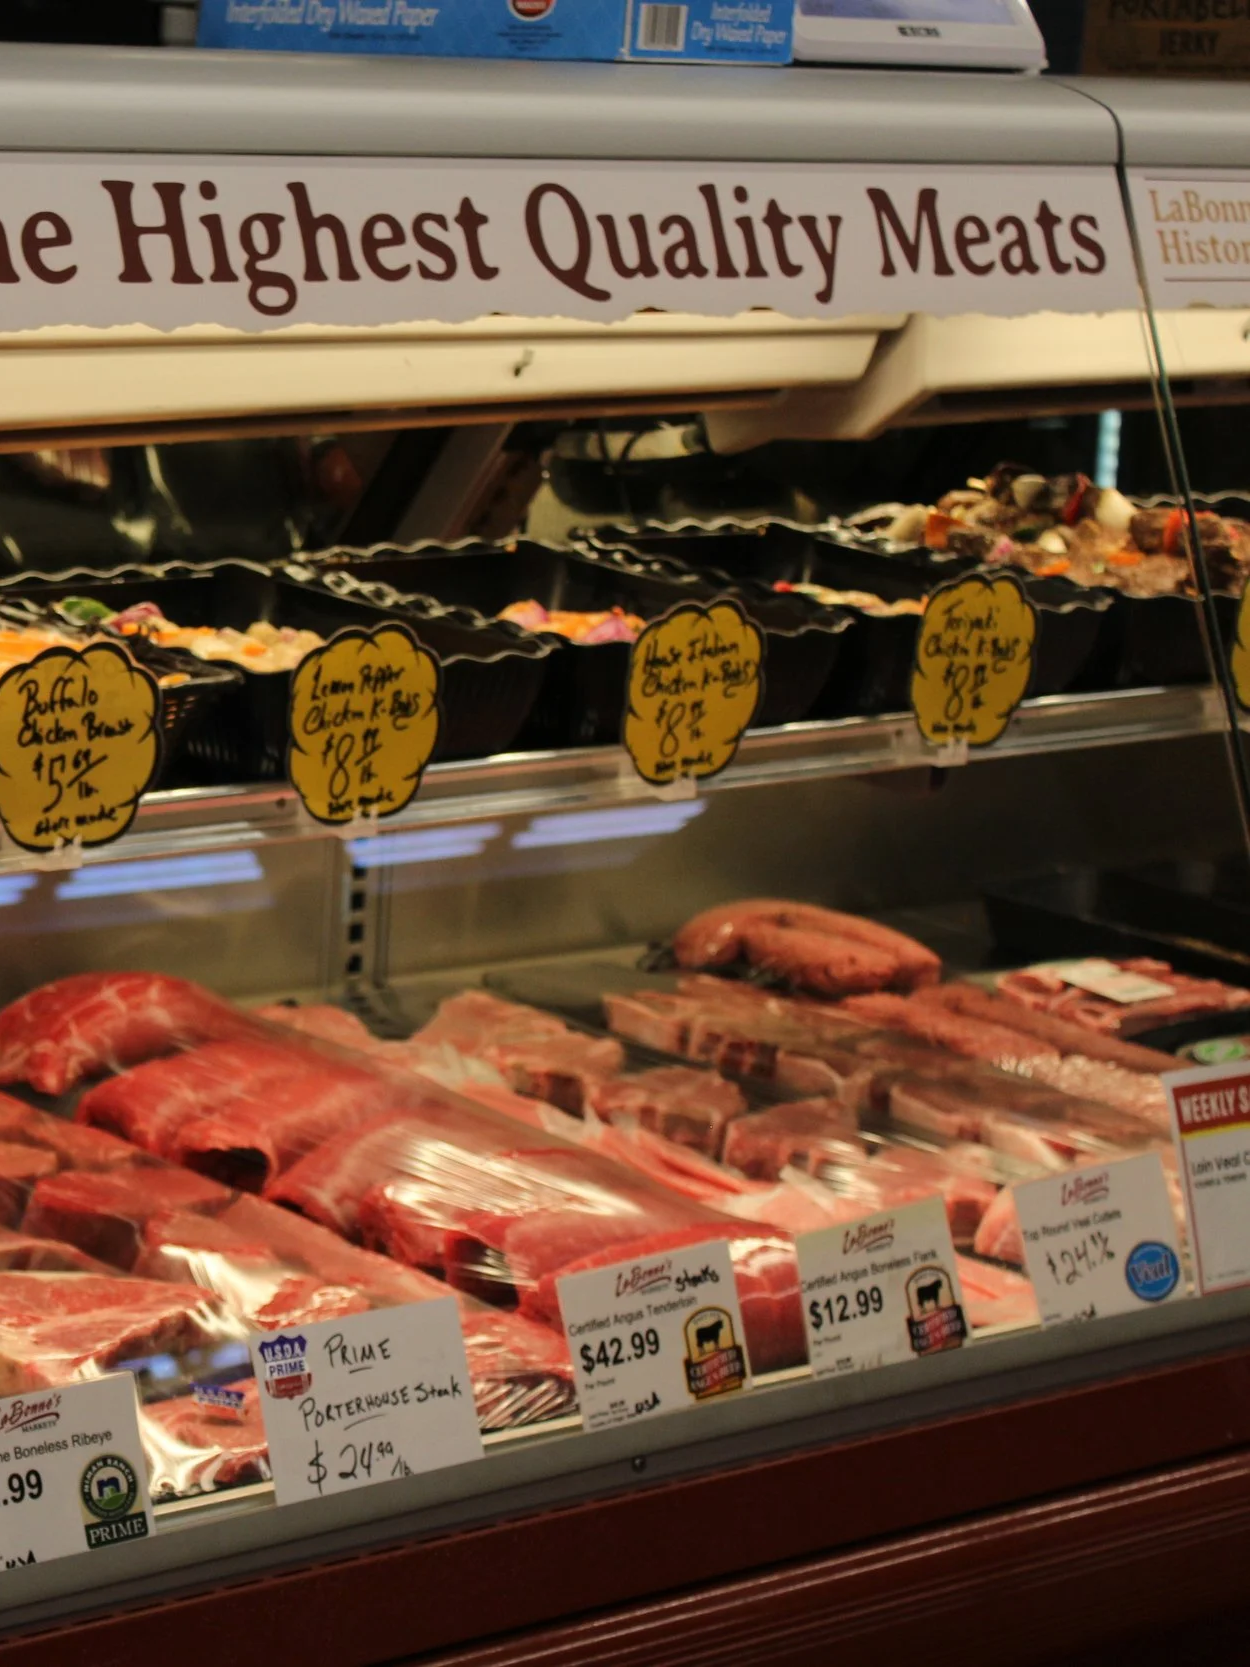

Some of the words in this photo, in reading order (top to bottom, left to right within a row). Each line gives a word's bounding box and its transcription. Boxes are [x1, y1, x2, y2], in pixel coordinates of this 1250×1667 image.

[100, 179, 501, 317] Highest
[524, 182, 842, 303] Quality
[866, 186, 1107, 277] Meats
[18, 674, 99, 718] Buffalo
[1179, 1088, 1236, 1124] WEEKLY
[568, 1317, 610, 1337] Certified
[612, 1308, 644, 1325] Angus
[809, 1286, 884, 1334] $12.99
[263, 1341, 303, 1362] USDA
[579, 1328, 661, 1375] $42.99
[268, 1360, 305, 1377] PRIME
[14, 1439, 69, 1460] Boneless
[71, 1429, 113, 1450] Ribeye
[89, 1517, 146, 1544] PRIME
